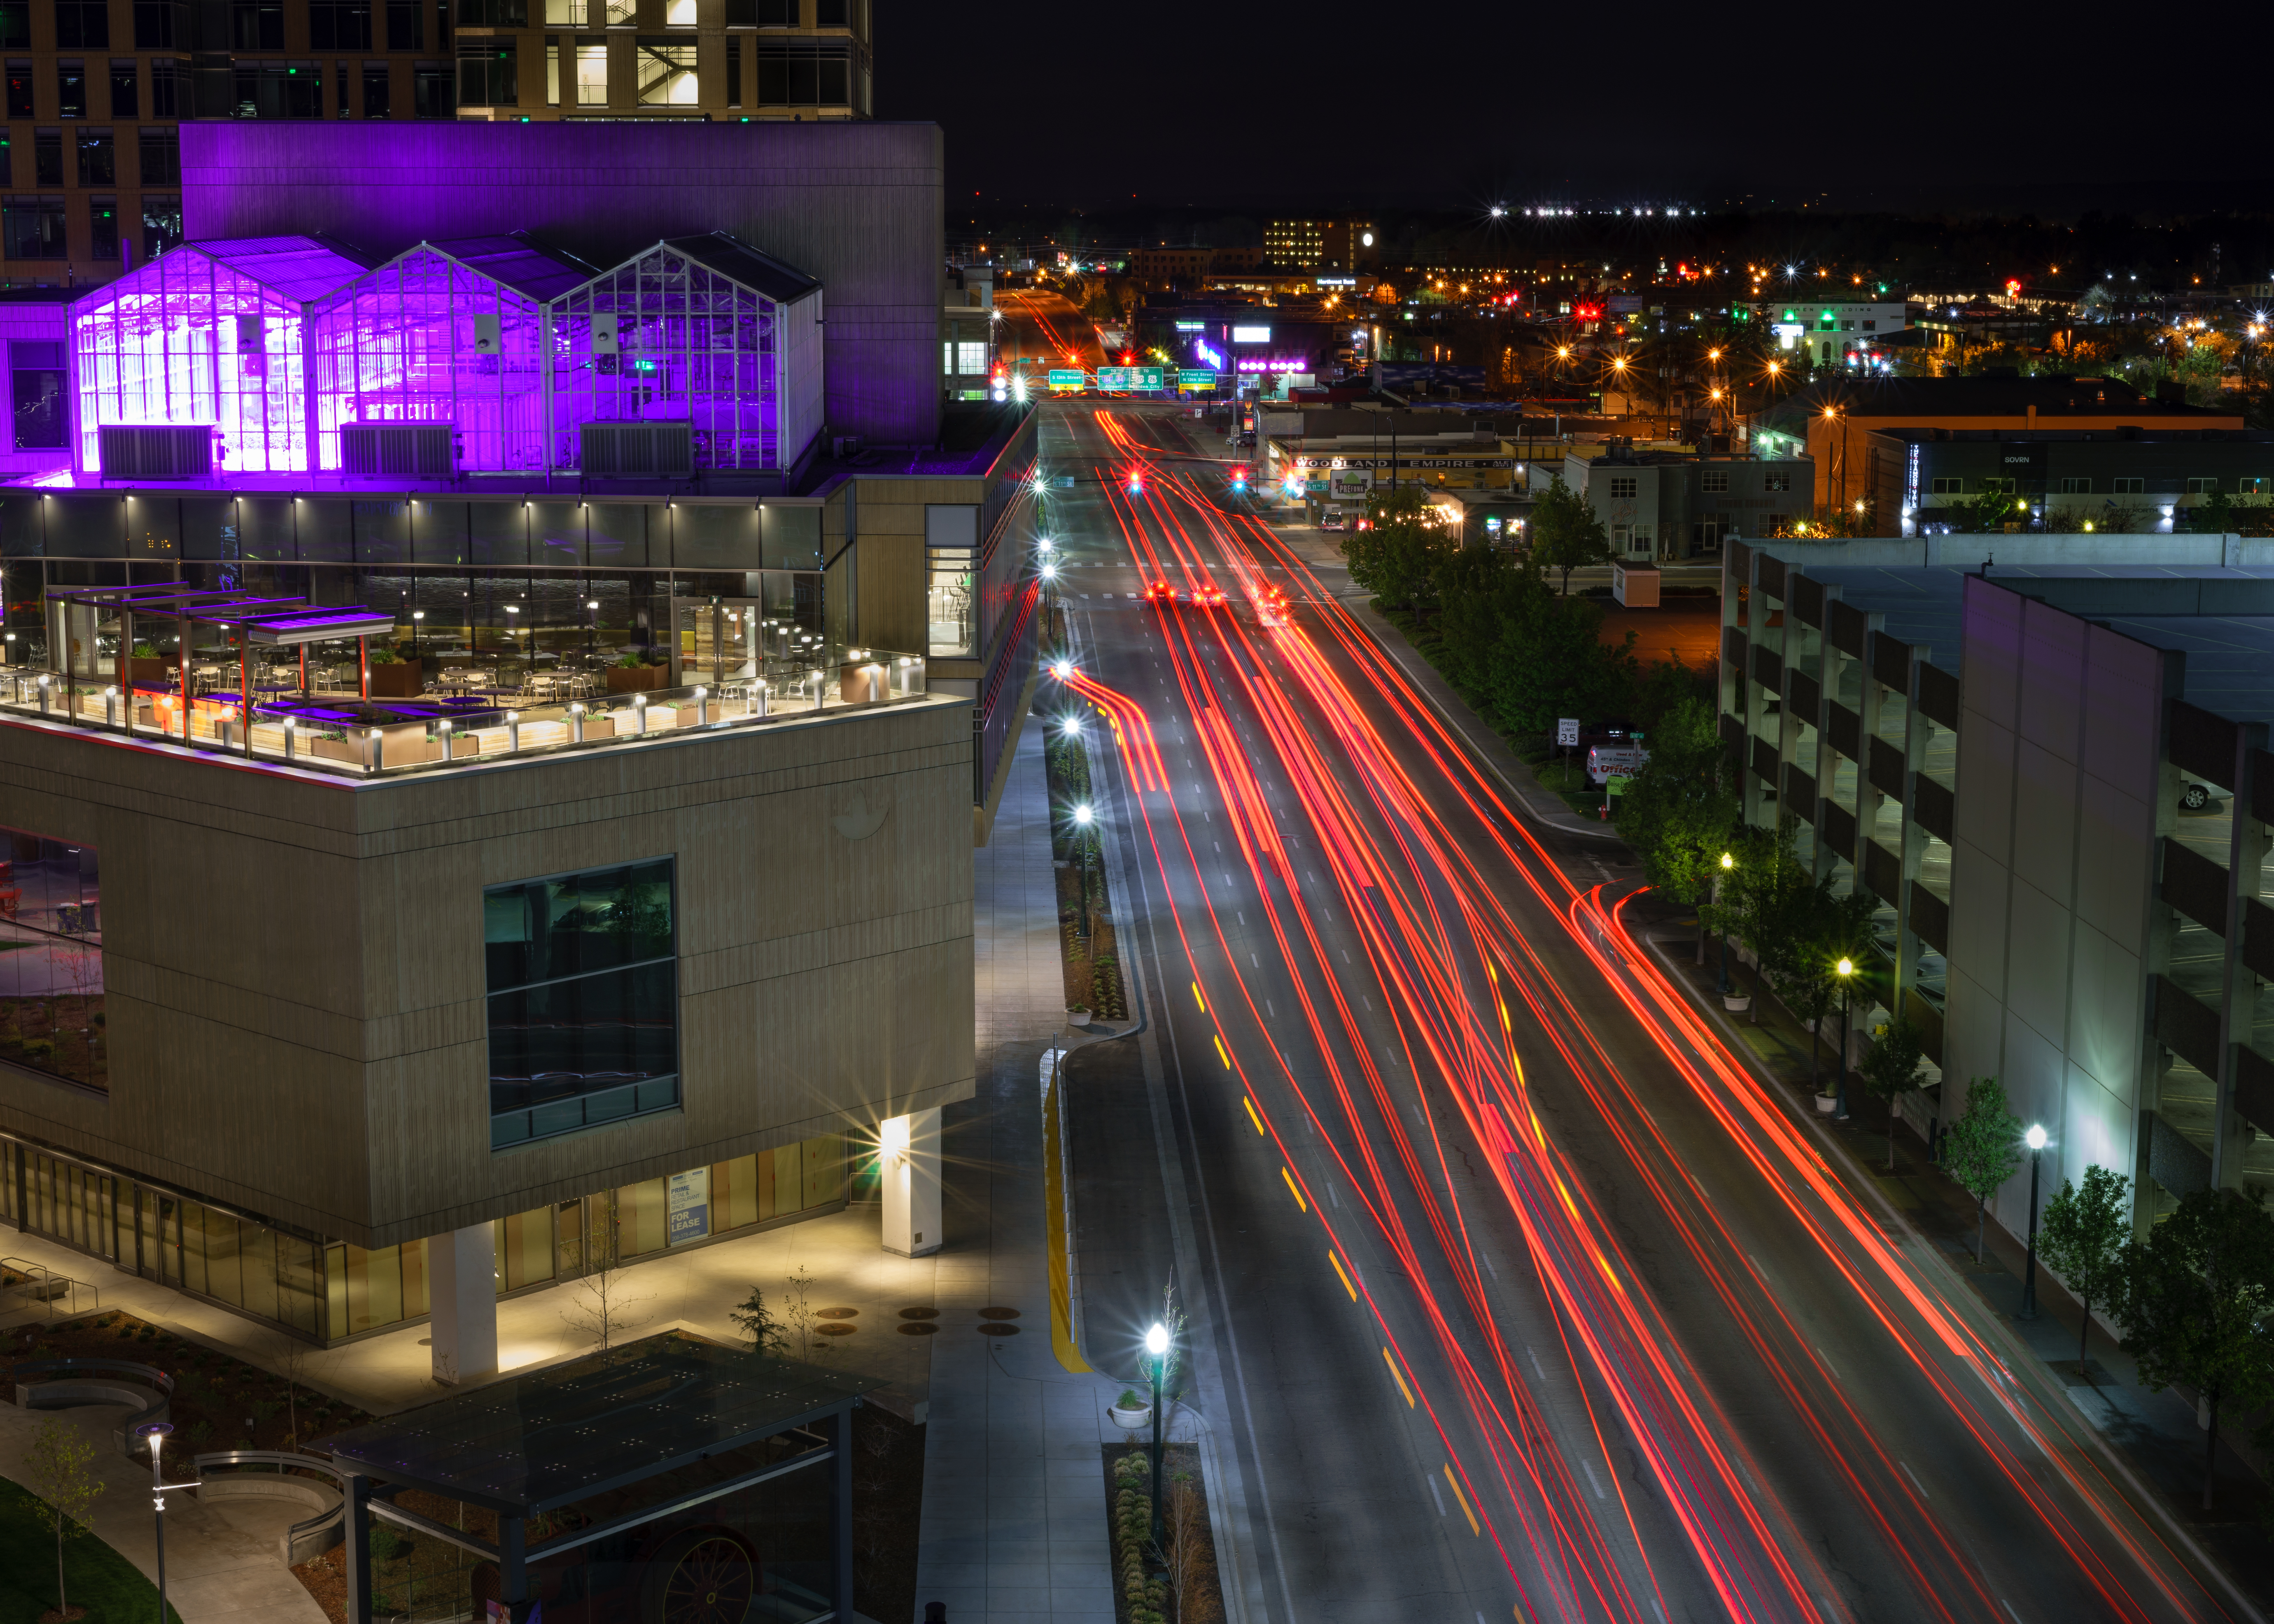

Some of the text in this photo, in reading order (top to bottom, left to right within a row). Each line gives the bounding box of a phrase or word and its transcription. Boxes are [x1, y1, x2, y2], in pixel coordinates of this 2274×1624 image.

[1560, 734, 1576, 742] 35
[1600, 764, 1635, 774] Office
[671, 1185, 690, 1194] PRIME
[671, 1194, 700, 1205] RESTAURANT
[672, 1211, 690, 1223] FOR
[672, 1218, 700, 1233] LEASE
[672, 1230, 700, 1242] 208-378-4600
